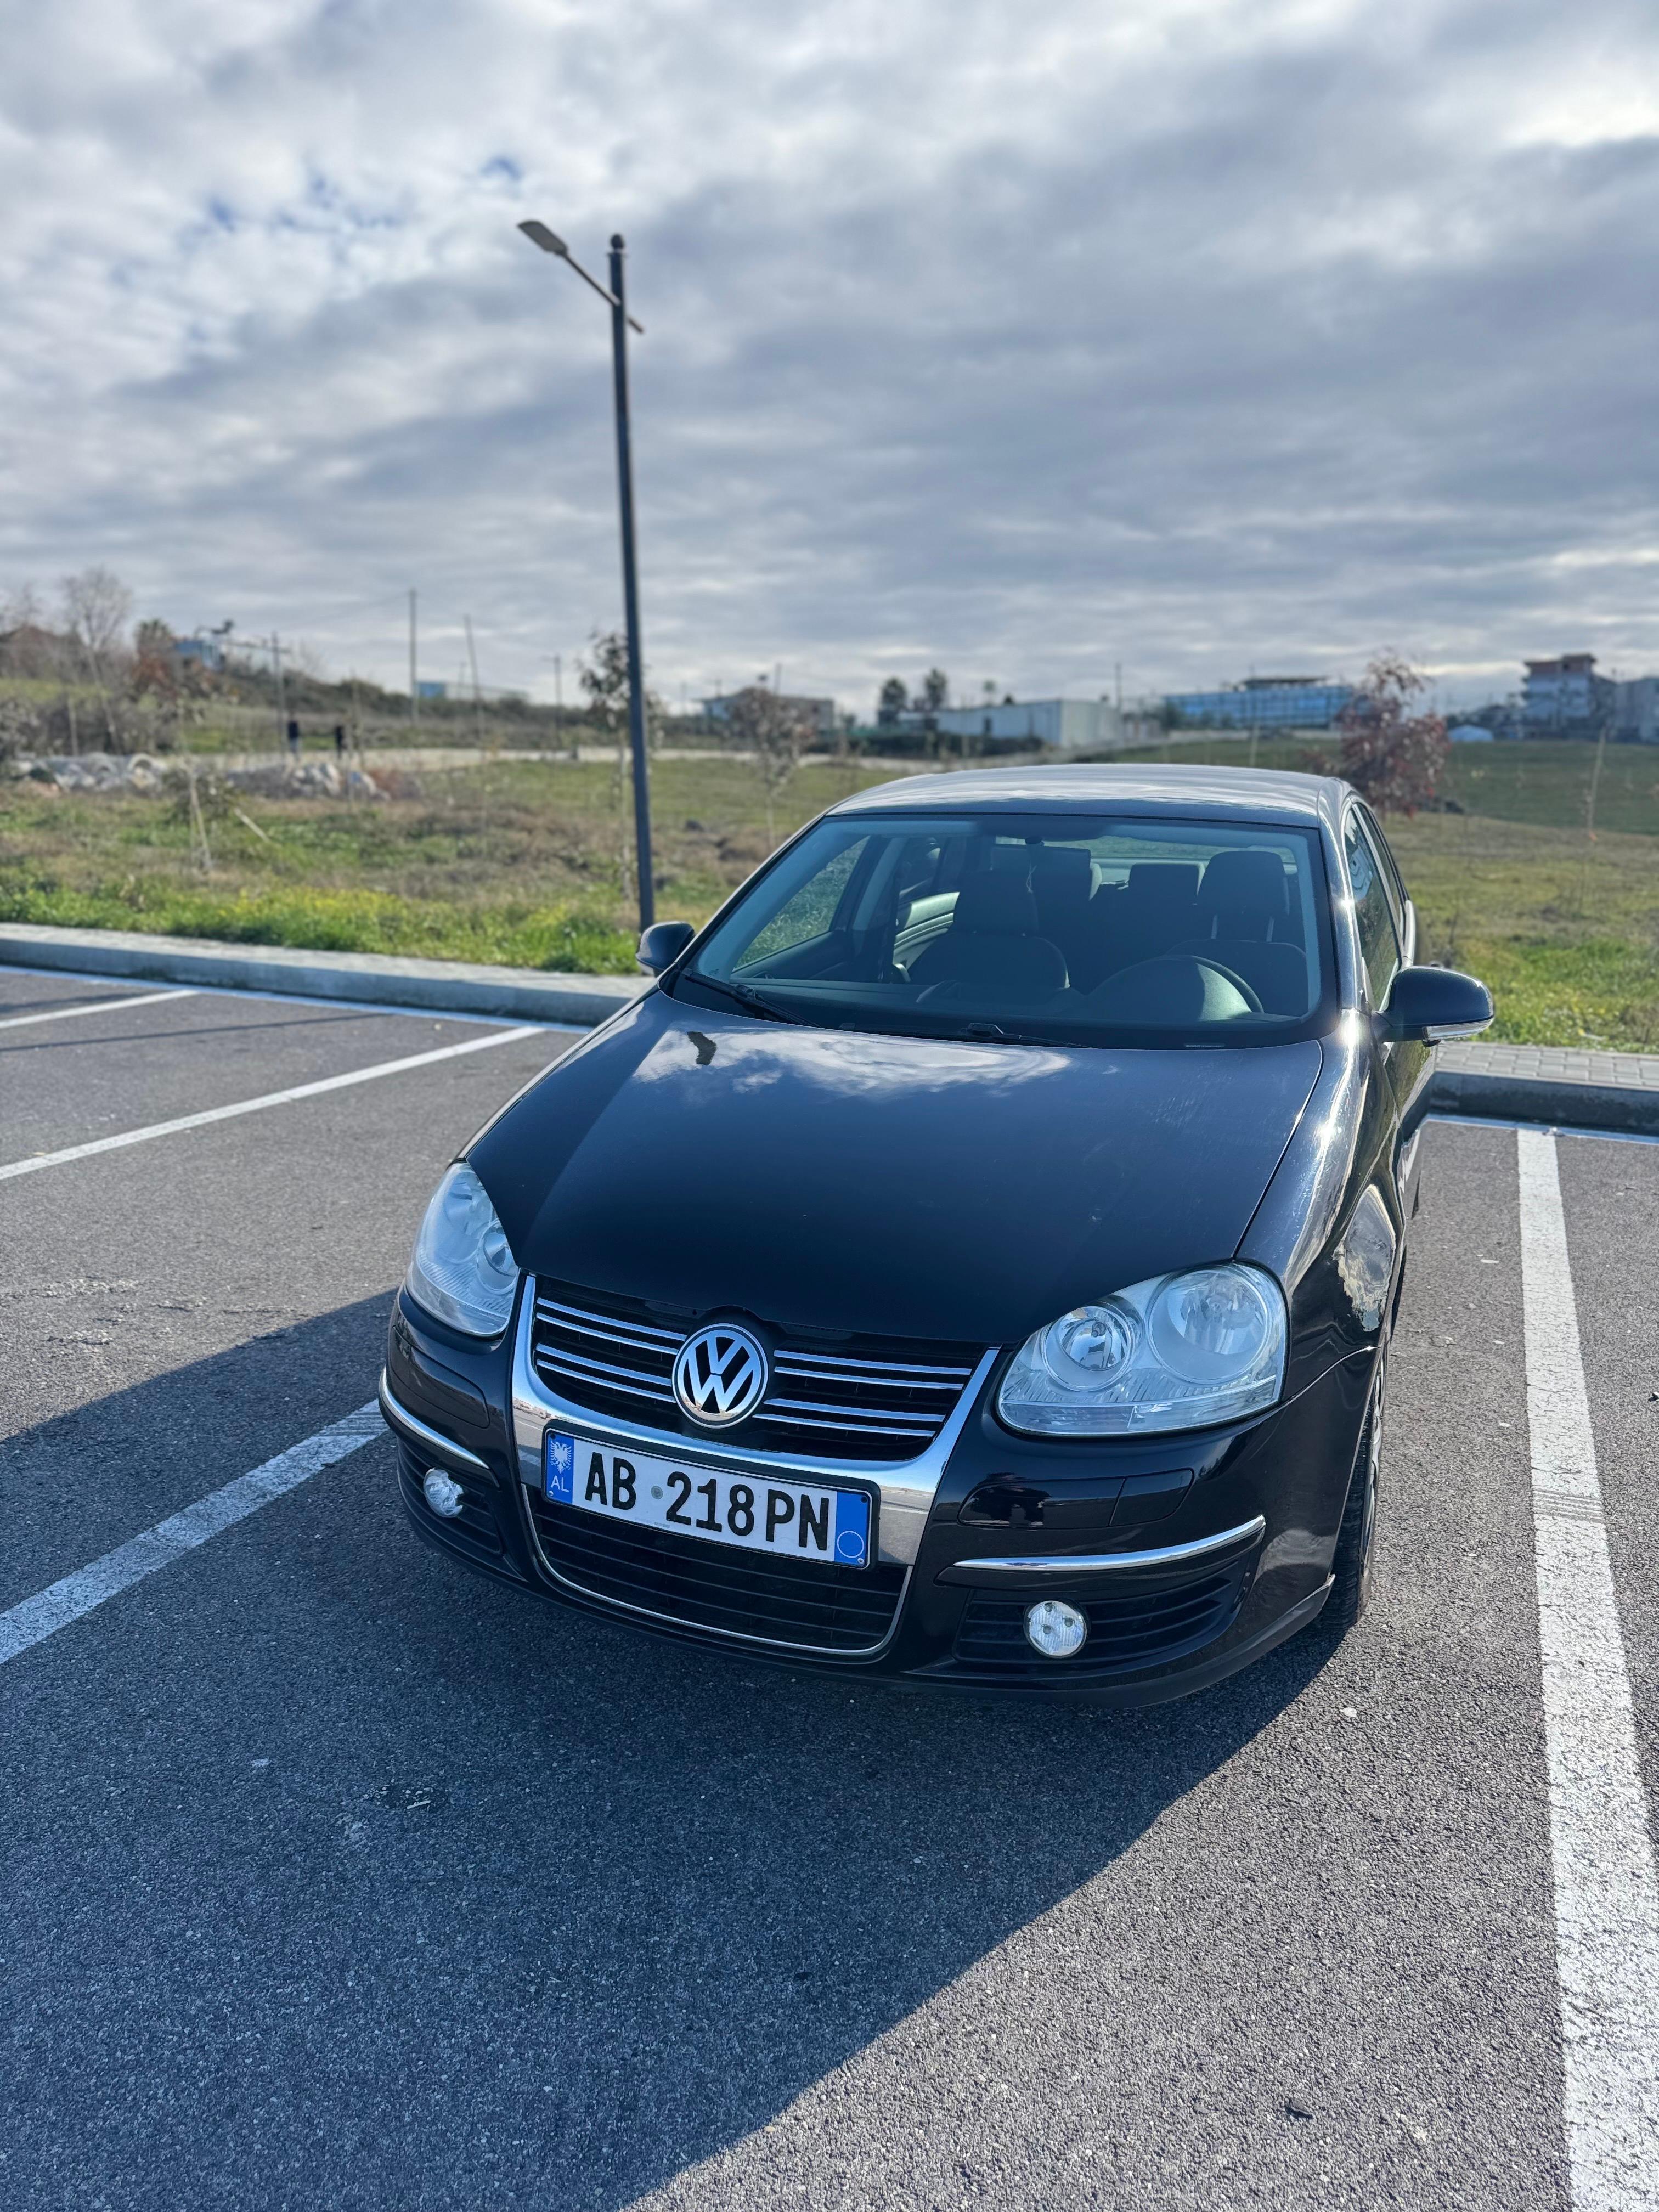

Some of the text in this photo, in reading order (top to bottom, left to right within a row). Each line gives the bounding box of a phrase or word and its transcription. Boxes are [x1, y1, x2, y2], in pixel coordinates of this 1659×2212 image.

[678, 1330, 761, 1421] VW
[550, 1475, 570, 1493] AL
[585, 1452, 830, 1551] AB 218 PN
